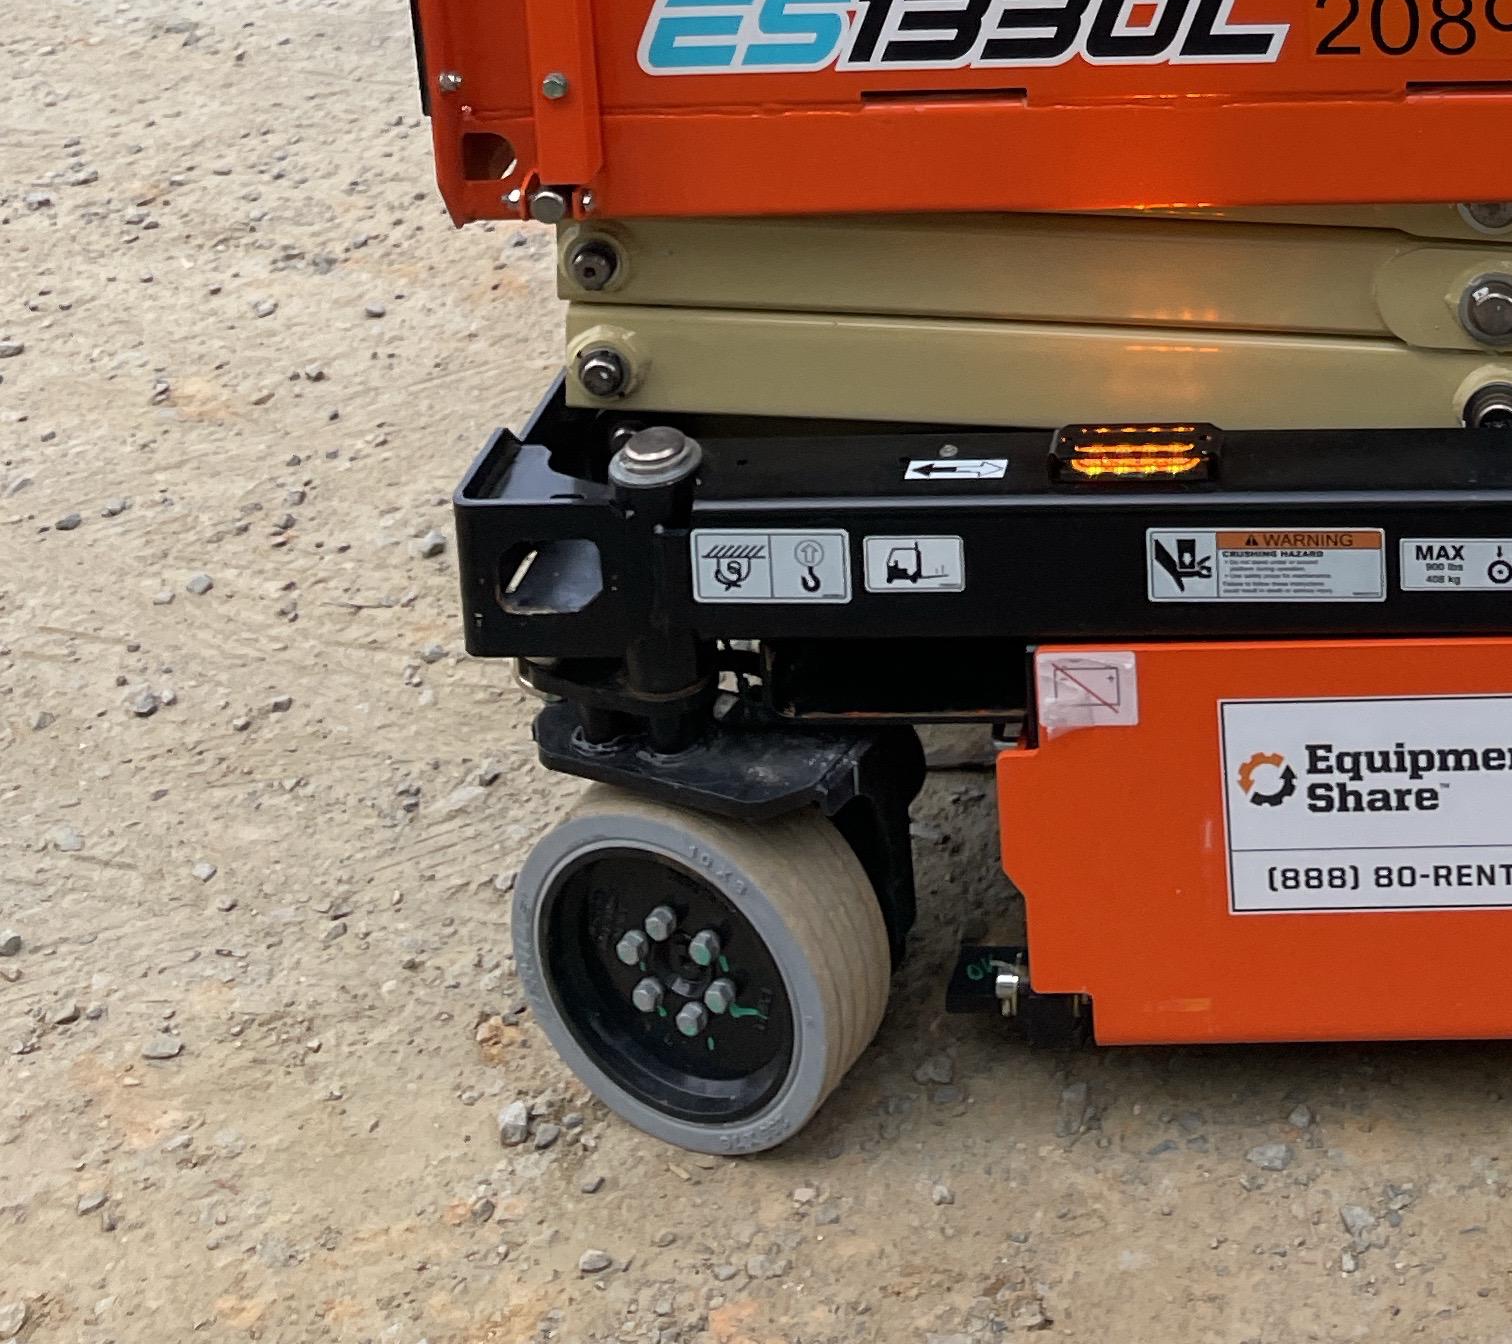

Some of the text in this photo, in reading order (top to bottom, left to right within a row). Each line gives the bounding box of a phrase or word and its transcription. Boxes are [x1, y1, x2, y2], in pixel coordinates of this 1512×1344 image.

[1263, 534, 1354, 547] WARNING
[1222, 550, 1325, 558] CRUSHING HAZARD
[1415, 545, 1465, 561] MAX
[1448, 575, 1461, 586] kg
[1307, 781, 1439, 813] Share
[1268, 864, 1360, 892] (888)
